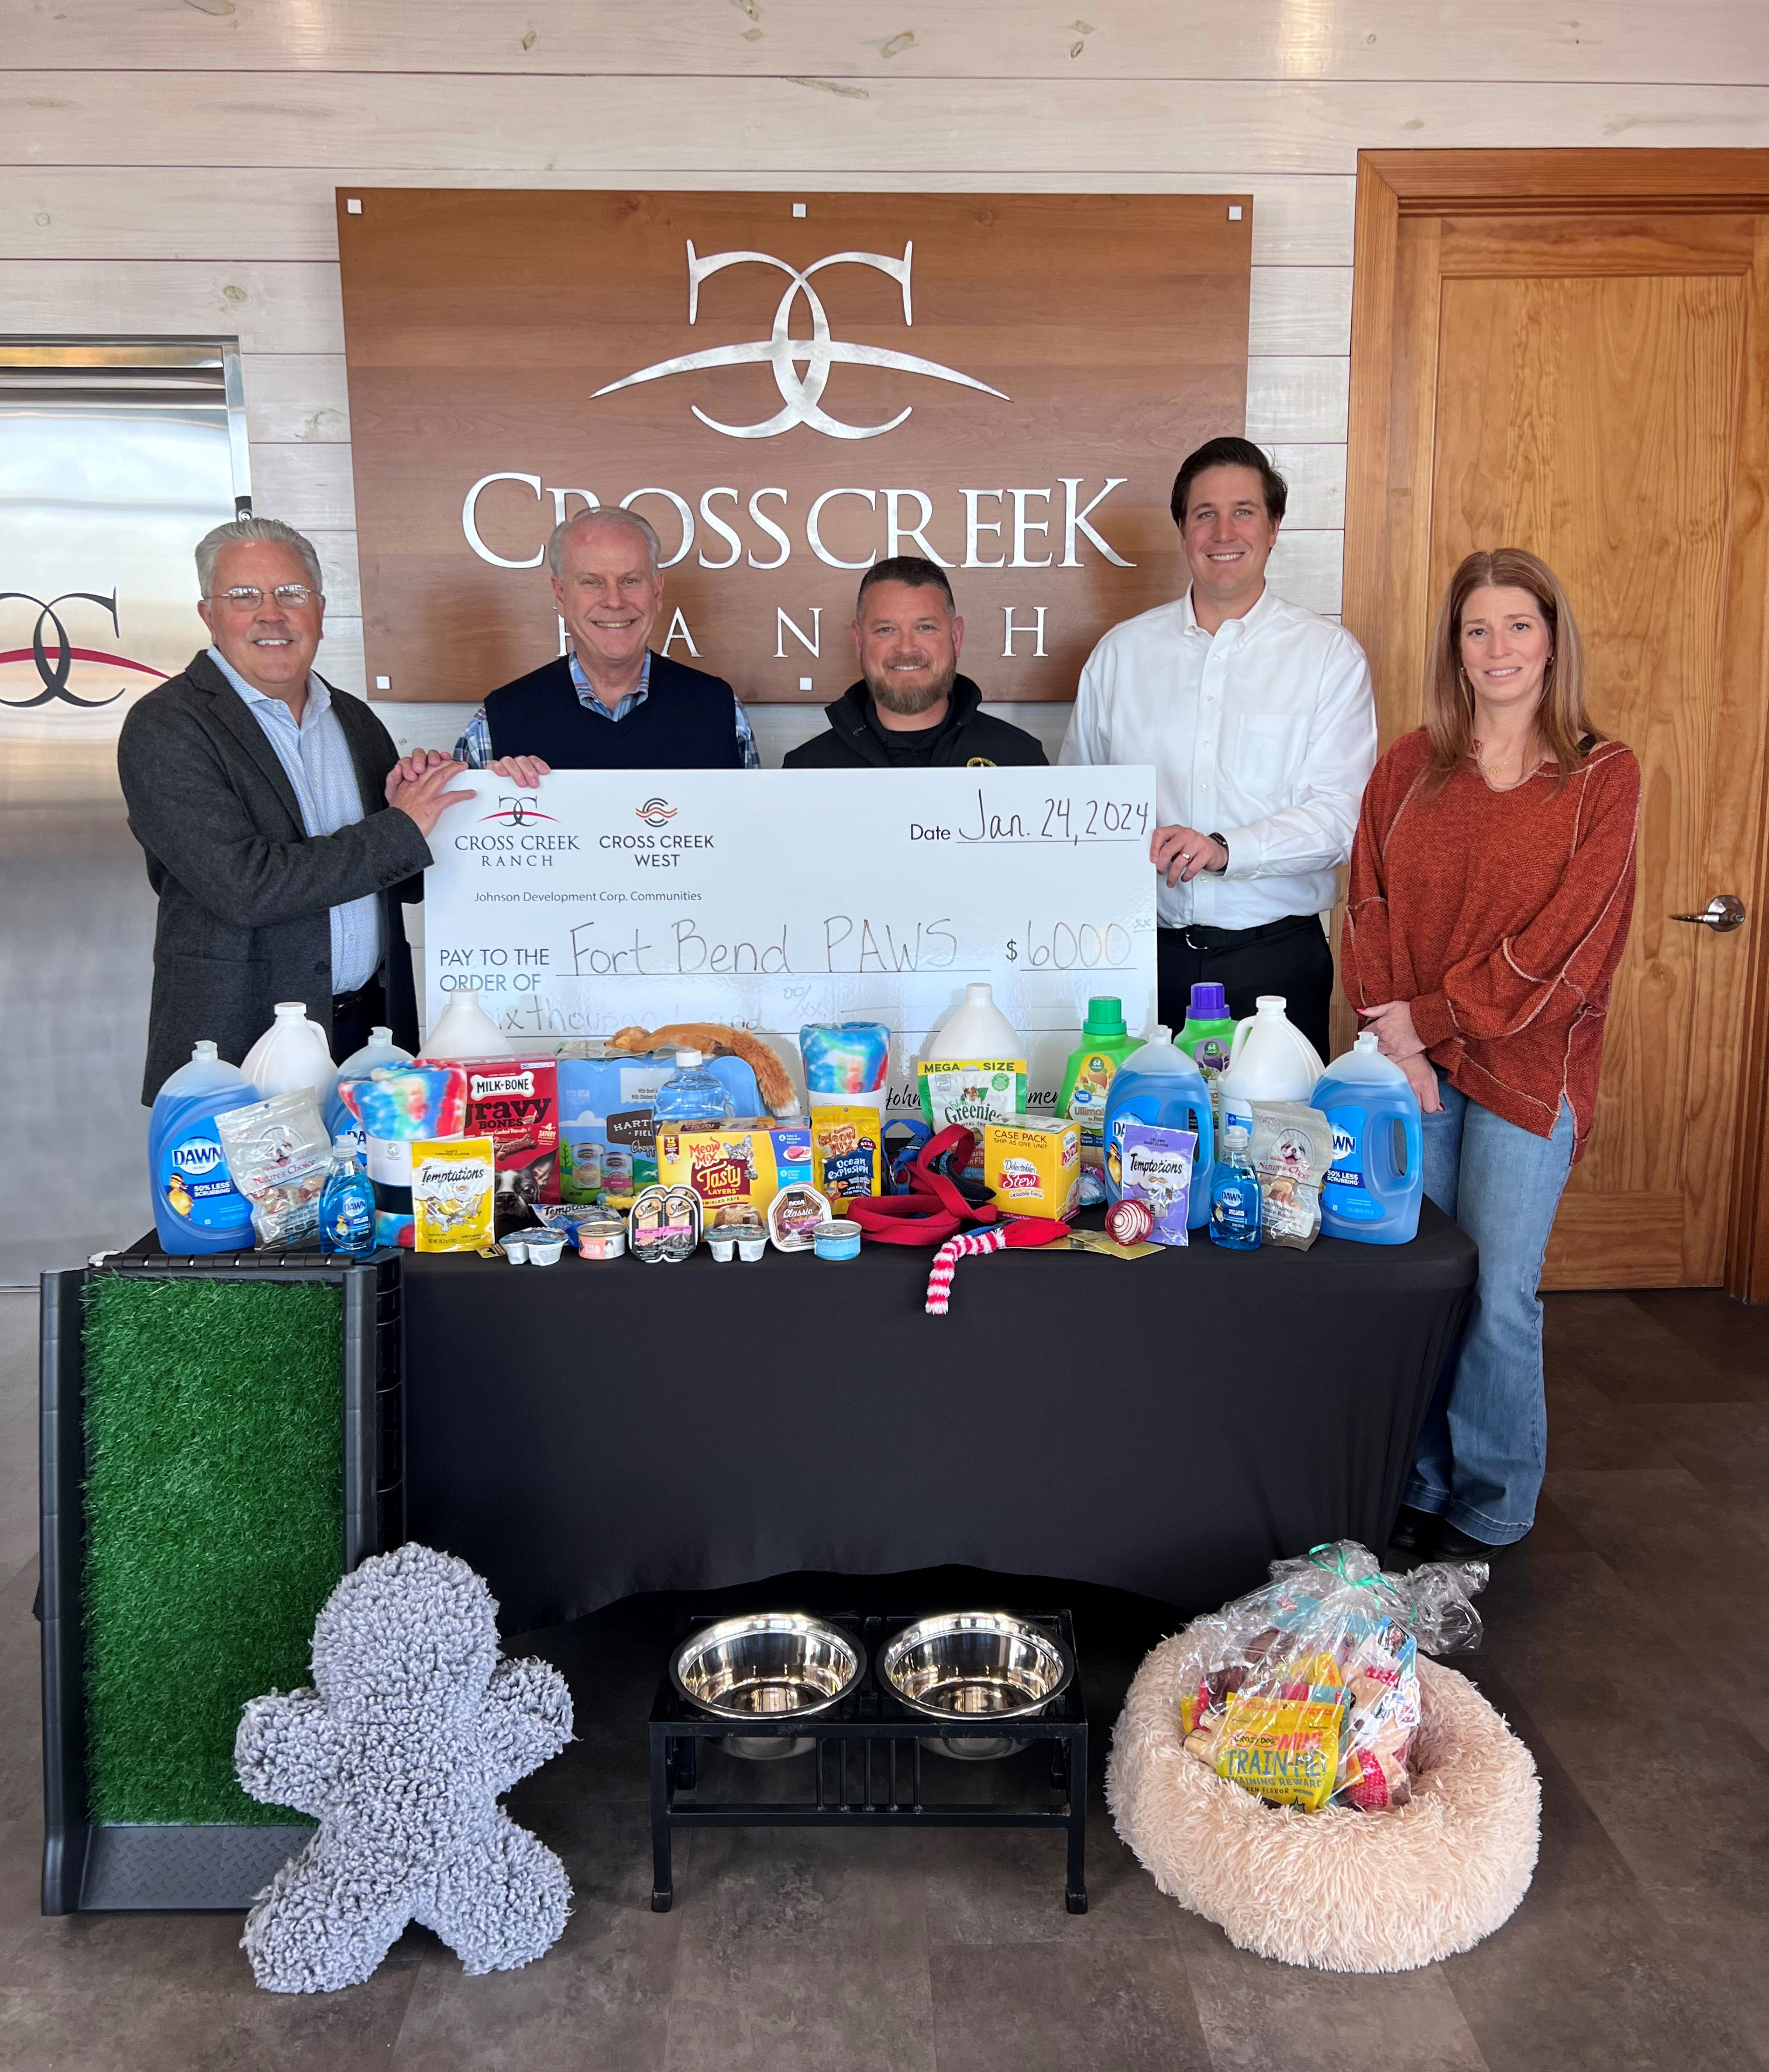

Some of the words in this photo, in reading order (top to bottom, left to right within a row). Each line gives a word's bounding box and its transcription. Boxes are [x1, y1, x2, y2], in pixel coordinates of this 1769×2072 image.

[806, 477, 1137, 569] CREEK
[552, 606, 1049, 659] ANH
[959, 789, 1030, 841] Jan.
[911, 824, 951, 840] Date
[455, 836, 514, 850] CROSS
[521, 836, 581, 850] CREEK
[599, 836, 655, 848] CROSS
[660, 835, 714, 848] CREEK
[481, 855, 553, 867] RANCH
[634, 854, 680, 867] WEST
[474, 891, 520, 903] Johnson
[523, 891, 597, 903] Development
[600, 891, 628, 903] Corp.
[631, 891, 702, 902] Communities
[570, 922, 652, 976] Fort
[671, 918, 795, 974] Bend
[823, 915, 957, 973] PAWS
[1028, 920, 1132, 970] 6000
[440, 949, 474, 967] PAY
[480, 948, 508, 966] TO
[514, 948, 550, 965] THE
[439, 974, 508, 992] ORDER
[512, 973, 542, 992] OF
[924, 1063, 961, 1073] MEGA
[983, 1062, 1015, 1071] SIZE
[478, 1118, 523, 1129] BONES
[994, 1129, 1018, 1140] CASE
[1022, 1133, 1047, 1143] PACK
[631, 1139, 656, 1157] Chopp
[689, 1136, 721, 1158] Meow
[1332, 1135, 1356, 1153] WN
[173, 1145, 225, 1167] DAWN
[836, 1157, 866, 1168] Ocean
[287, 1159, 316, 1175] Choice
[828, 1165, 869, 1180] explosion
[1004, 1159, 1035, 1173] Delectables
[1130, 1153, 1183, 1177] Temptations
[421, 1165, 485, 1186] Temptations
[696, 1160, 742, 1191] Tasty
[1003, 1171, 1037, 1189] Stew
[1327, 1176, 1358, 1186] SCRUBBING
[194, 1184, 211, 1193] 50%
[211, 1182, 230, 1191] LESS
[194, 1188, 230, 1198] SCRUBBING
[1221, 1191, 1244, 1202] DAWN
[343, 1201, 366, 1212] DAWN
[783, 1207, 814, 1219] Classic
[1260, 1736, 1275, 1744] DOG
